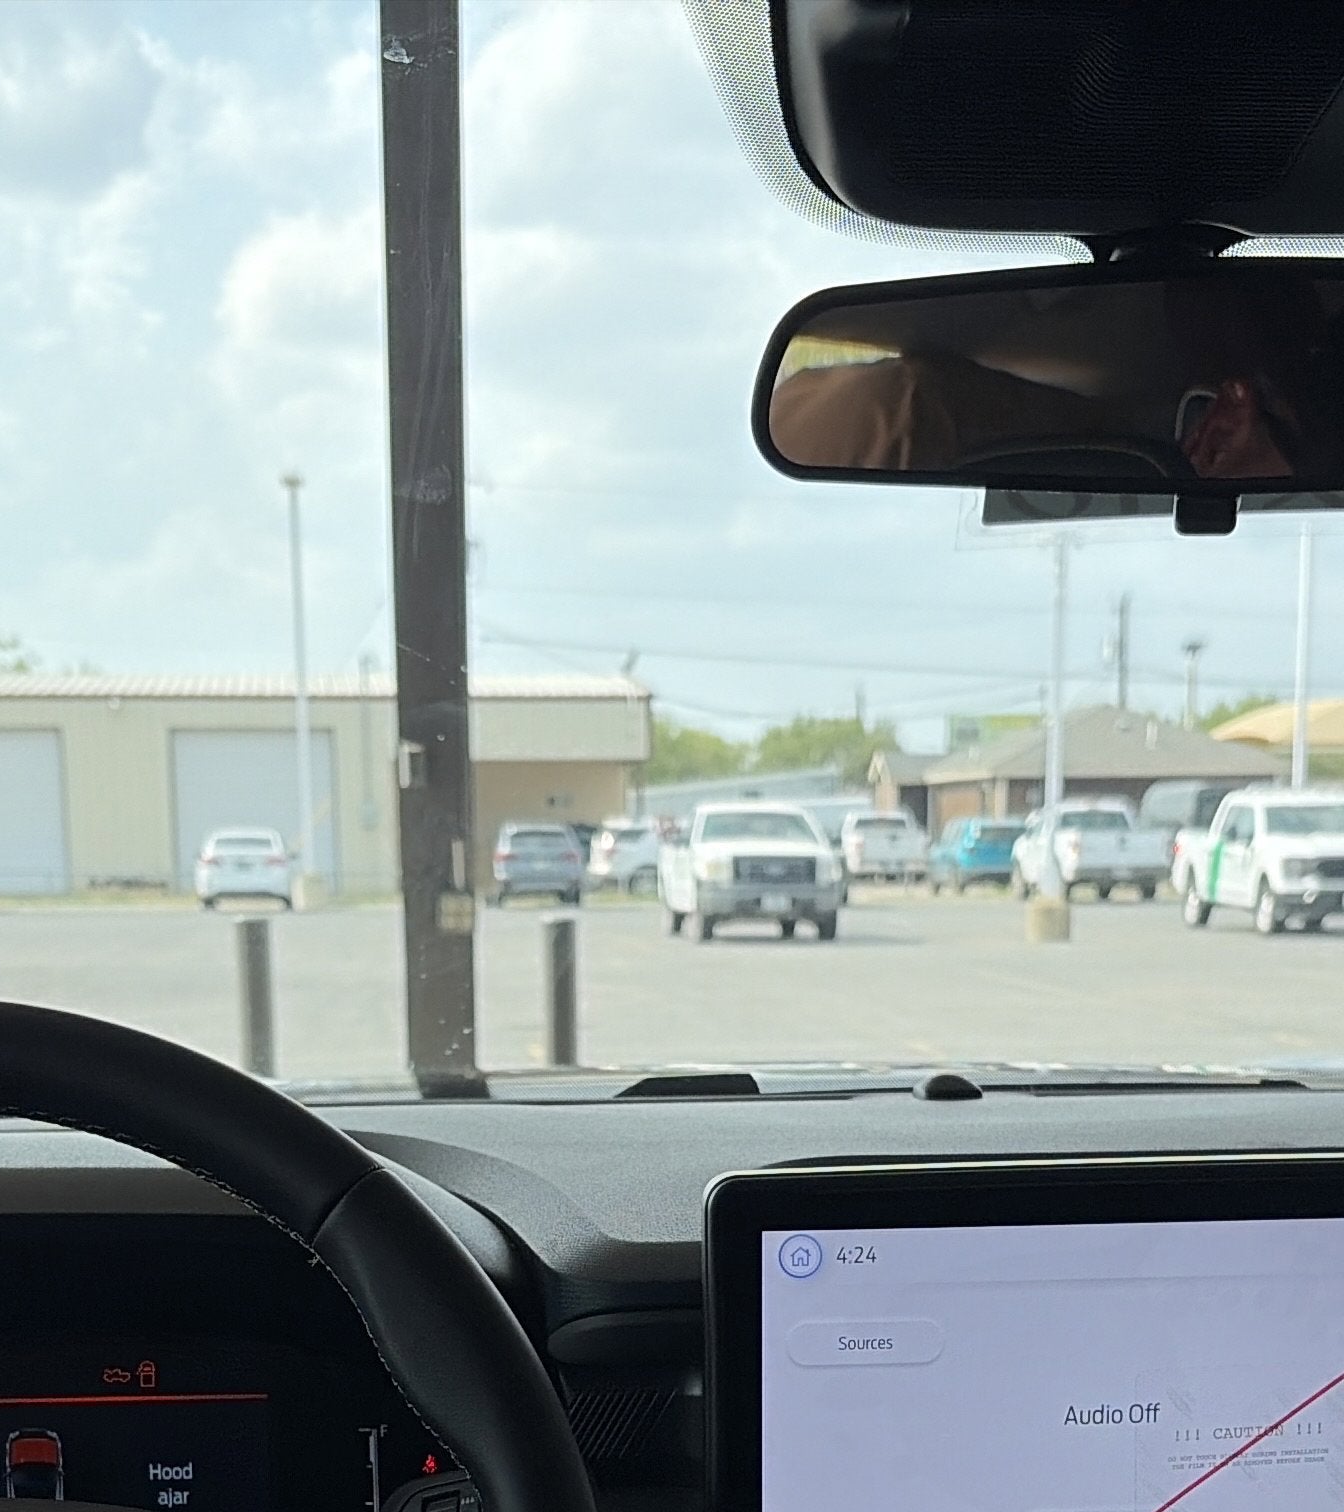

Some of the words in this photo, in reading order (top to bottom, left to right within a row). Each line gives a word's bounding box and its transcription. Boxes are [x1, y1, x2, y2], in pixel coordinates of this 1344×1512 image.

[836, 1245, 878, 1264] 4:24
[838, 1335, 894, 1351] Sources
[1063, 1403, 1124, 1426] Audio
[1128, 1402, 1161, 1424] Off
[148, 1461, 194, 1481] Hood
[157, 1487, 191, 1508] ajar
